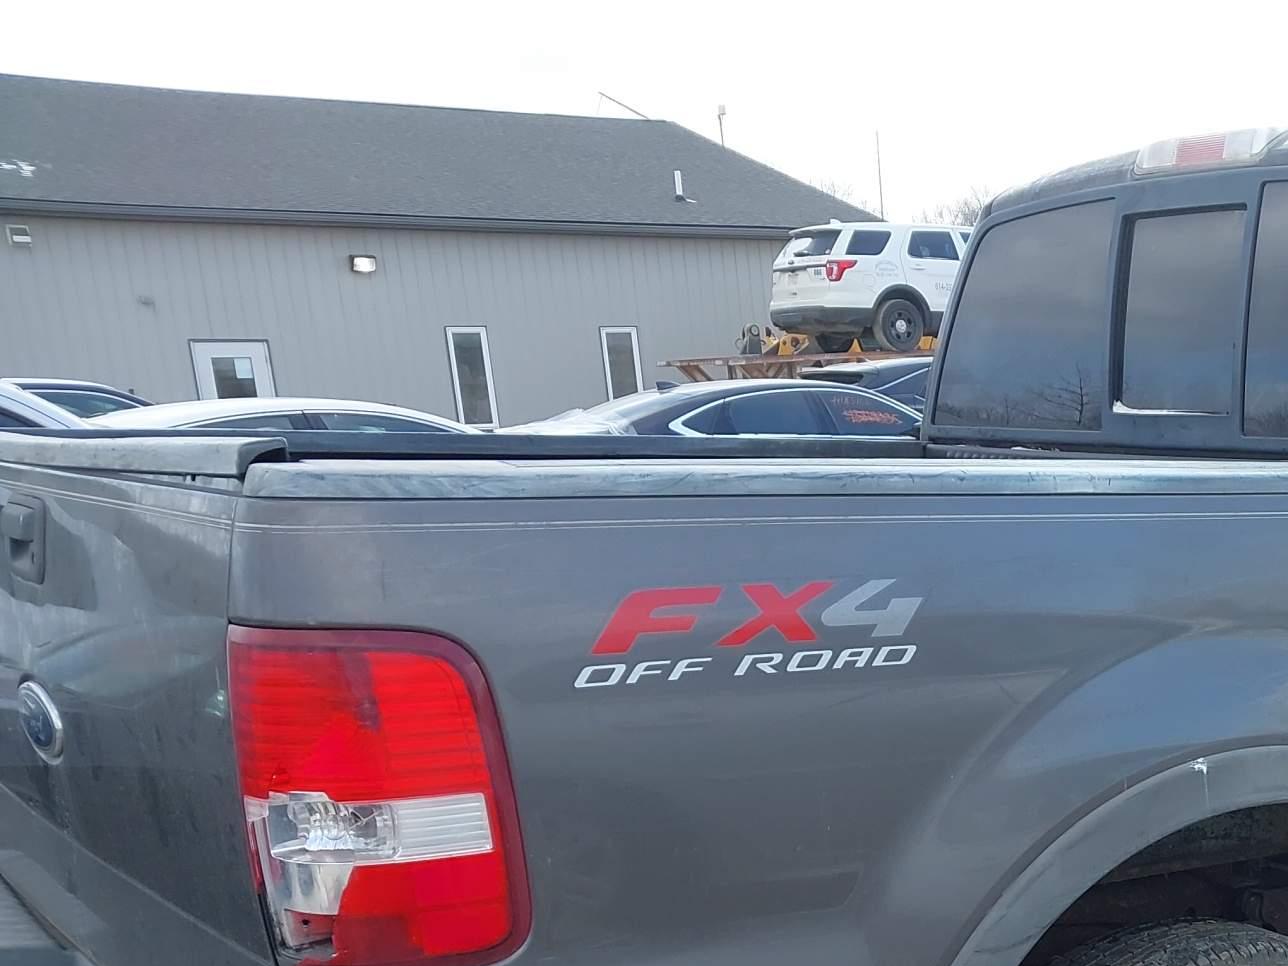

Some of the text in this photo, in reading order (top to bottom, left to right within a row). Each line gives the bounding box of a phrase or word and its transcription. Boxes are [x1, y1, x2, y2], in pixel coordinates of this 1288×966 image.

[591, 578, 924, 656] FX4
[573, 644, 918, 689] OFF ROAD
